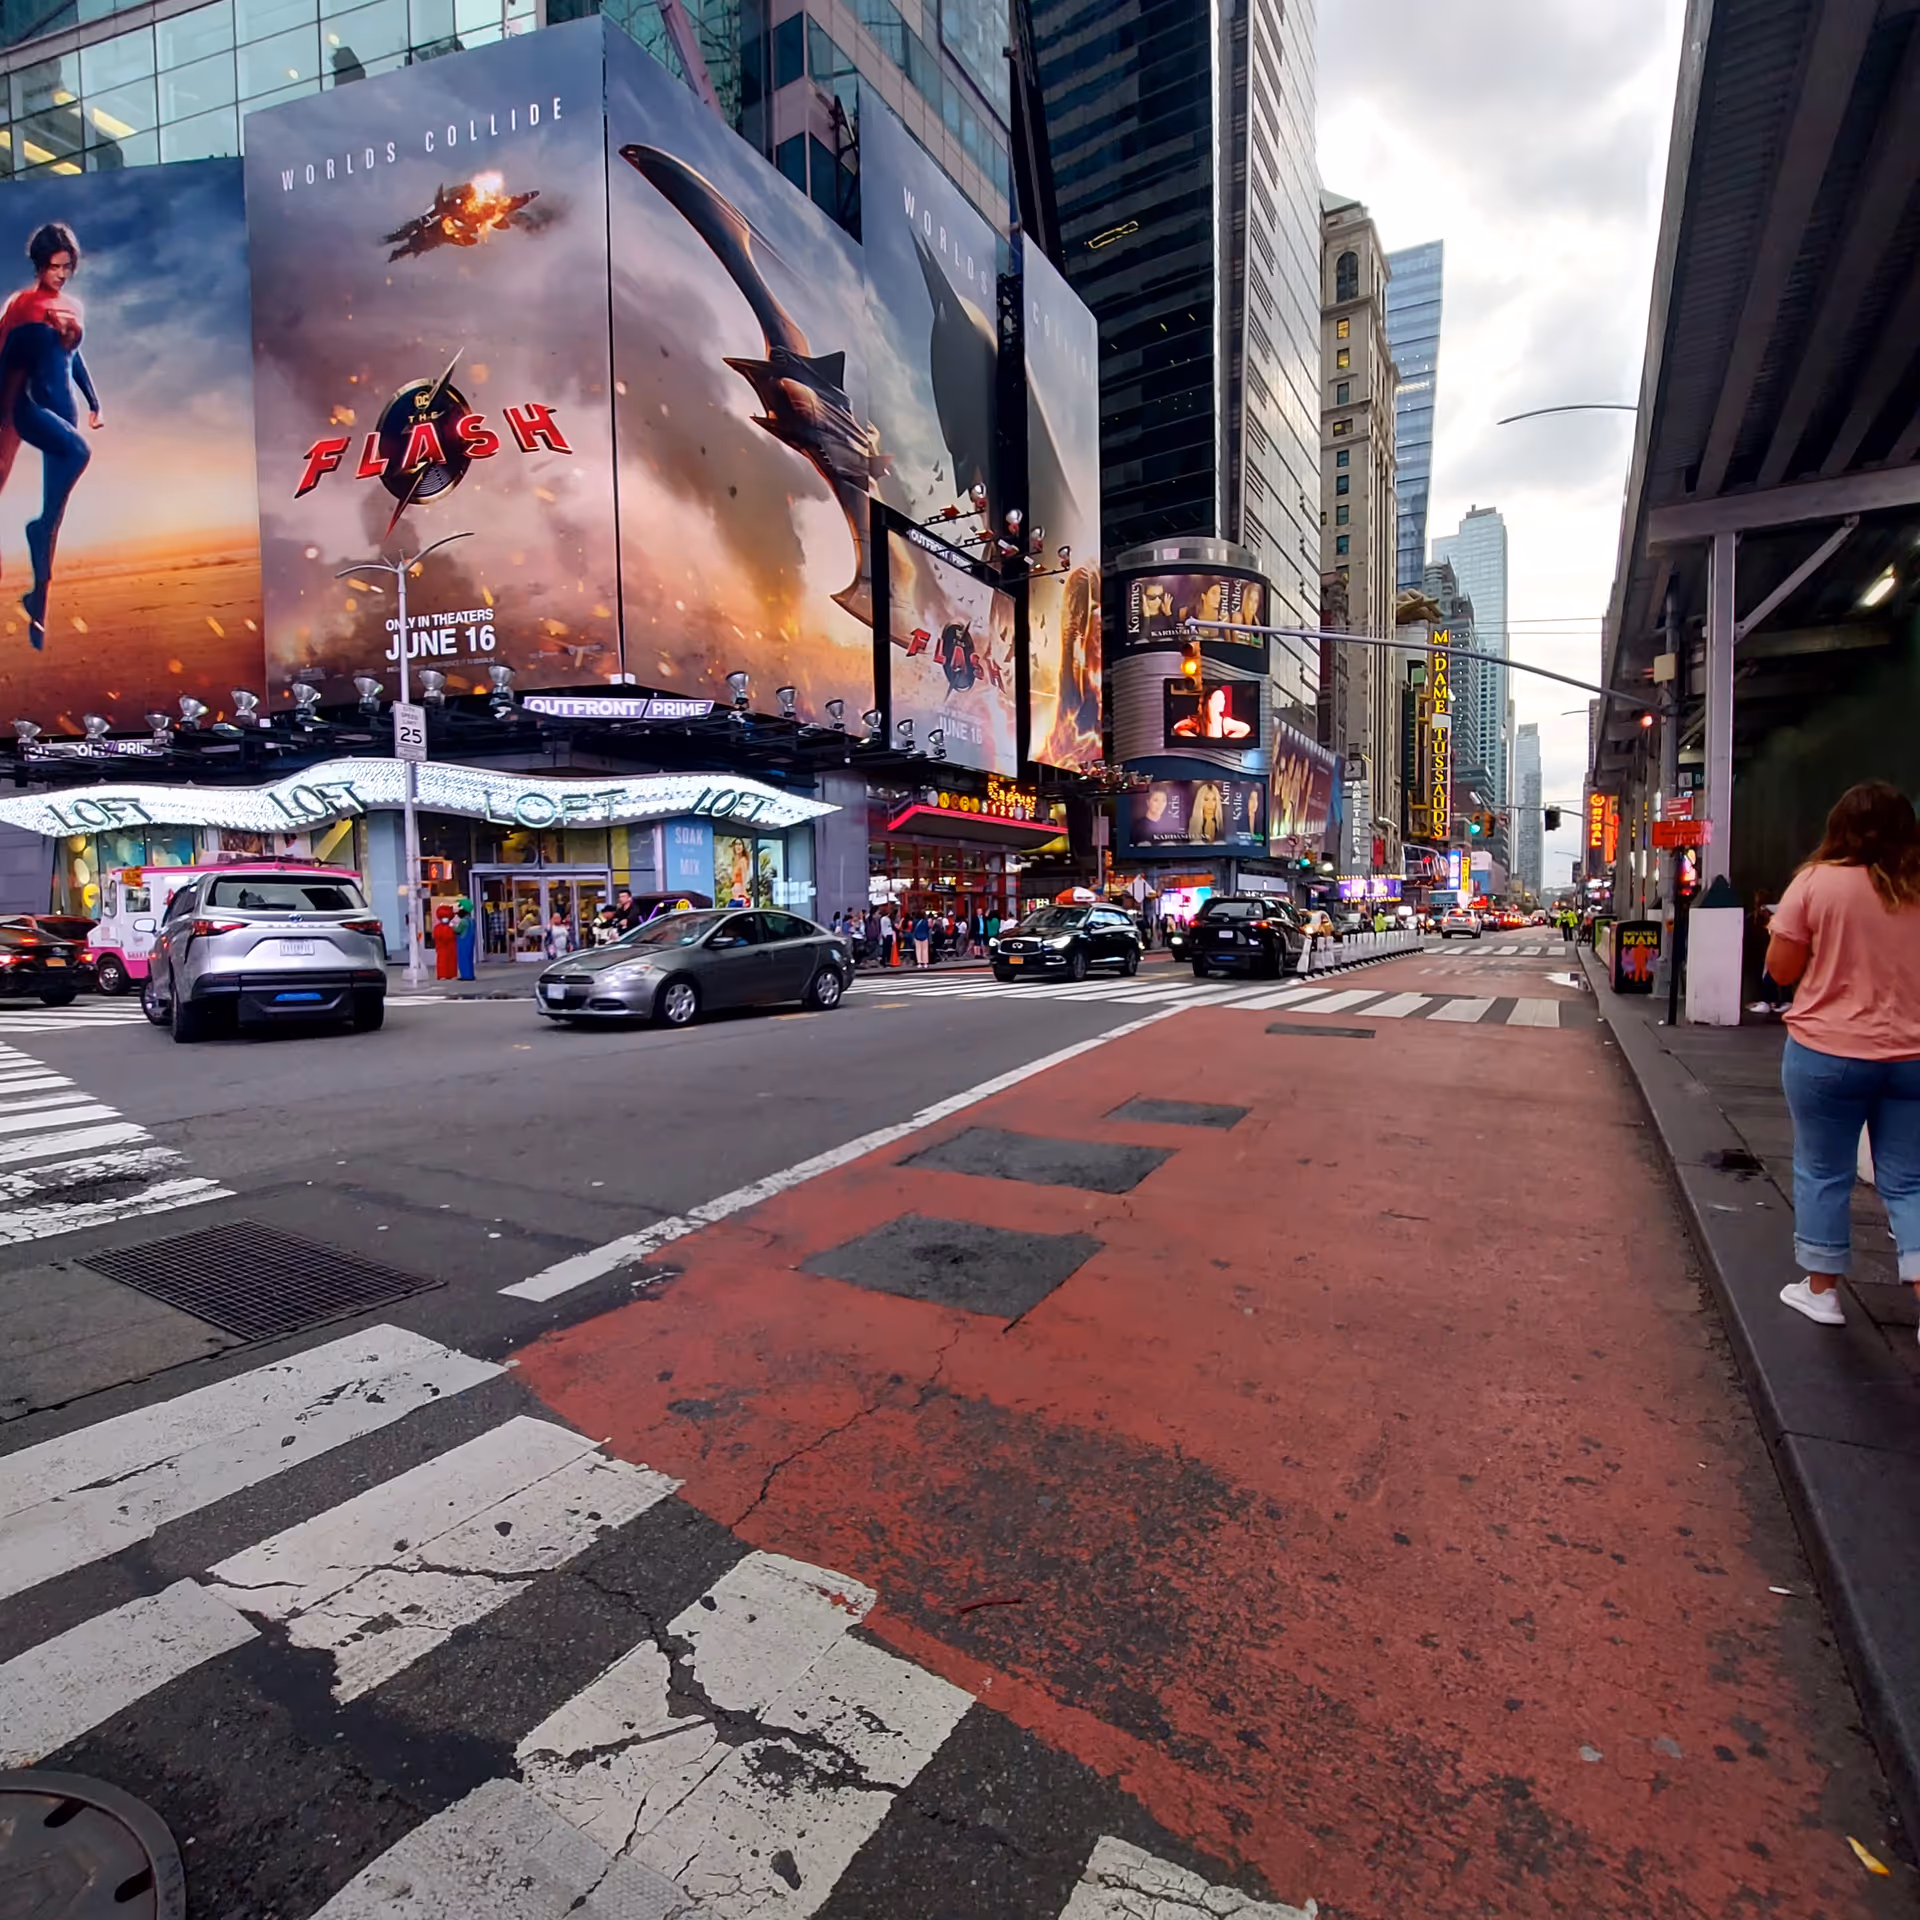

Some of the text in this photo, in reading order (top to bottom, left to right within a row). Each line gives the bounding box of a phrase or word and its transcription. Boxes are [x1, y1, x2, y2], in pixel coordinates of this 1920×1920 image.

[281, 96, 562, 192] WORLDS COLLIDE
[903, 186, 988, 295] WORLDS
[408, 411, 438, 423] THE
[415, 394, 430, 408] DC
[294, 403, 573, 499] FLASH
[418, 615, 430, 628] IN
[432, 608, 494, 626] THEATERS
[1128, 581, 1143, 634] Kourtney
[1218, 581, 1230, 624] Kendall
[385, 625, 496, 660] JUNE 16
[906, 628, 1006, 695] FLASH
[1433, 629, 1449, 713] MDAME
[529, 700, 707, 716] OUTFRONT PRIME
[400, 726, 423, 744] 25
[938, 714, 983, 745] JUNE 16
[1221, 781, 1231, 805] Kim
[1433, 727, 1447, 837] TUSSAUDS
[46, 797, 153, 830] LOFT
[267, 781, 368, 823] LOFT
[483, 788, 626, 828] LOFT
[691, 786, 776, 822] LOFT
[981, 800, 988, 813] S
[991, 803, 997, 815] 1
[1000, 805, 1006, 816] 2
[1168, 794, 1180, 819] Kris
[1232, 791, 1243, 821] Kylie
[674, 826, 704, 847] SOAK
[680, 857, 701, 876] MIX
[1623, 935, 1658, 945] MAN
